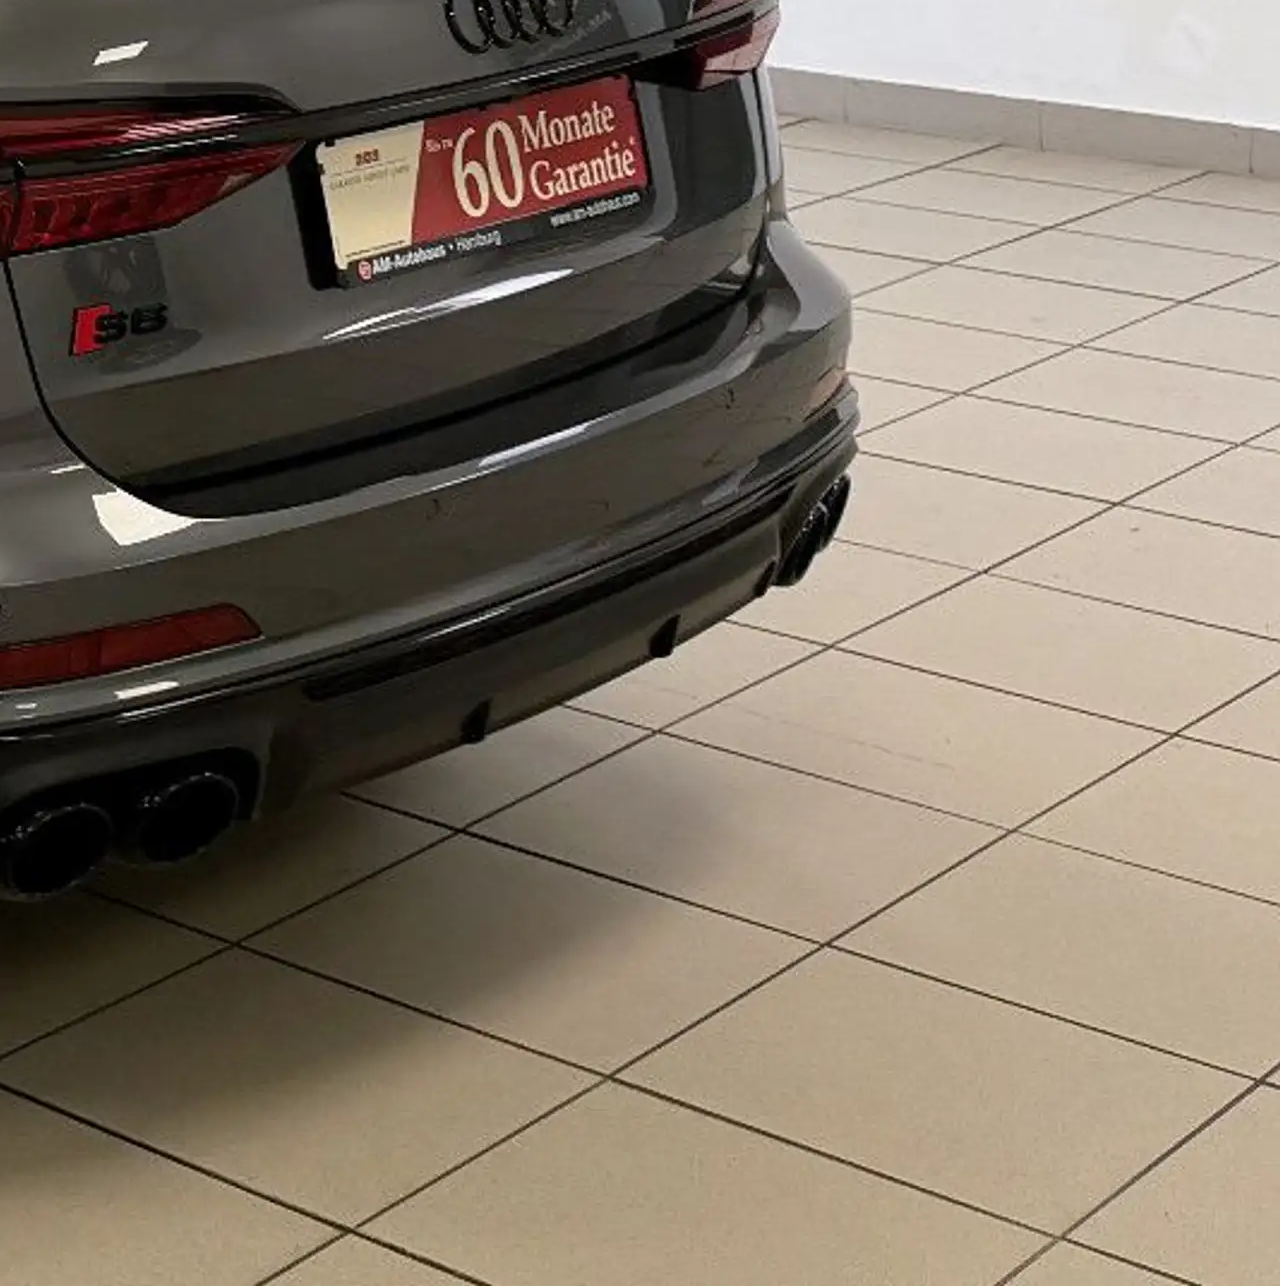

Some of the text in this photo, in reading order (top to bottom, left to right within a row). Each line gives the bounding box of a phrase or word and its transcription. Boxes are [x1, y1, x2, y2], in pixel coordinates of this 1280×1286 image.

[453, 100, 615, 217] 60 Monate
[85, 302, 169, 346] S6
